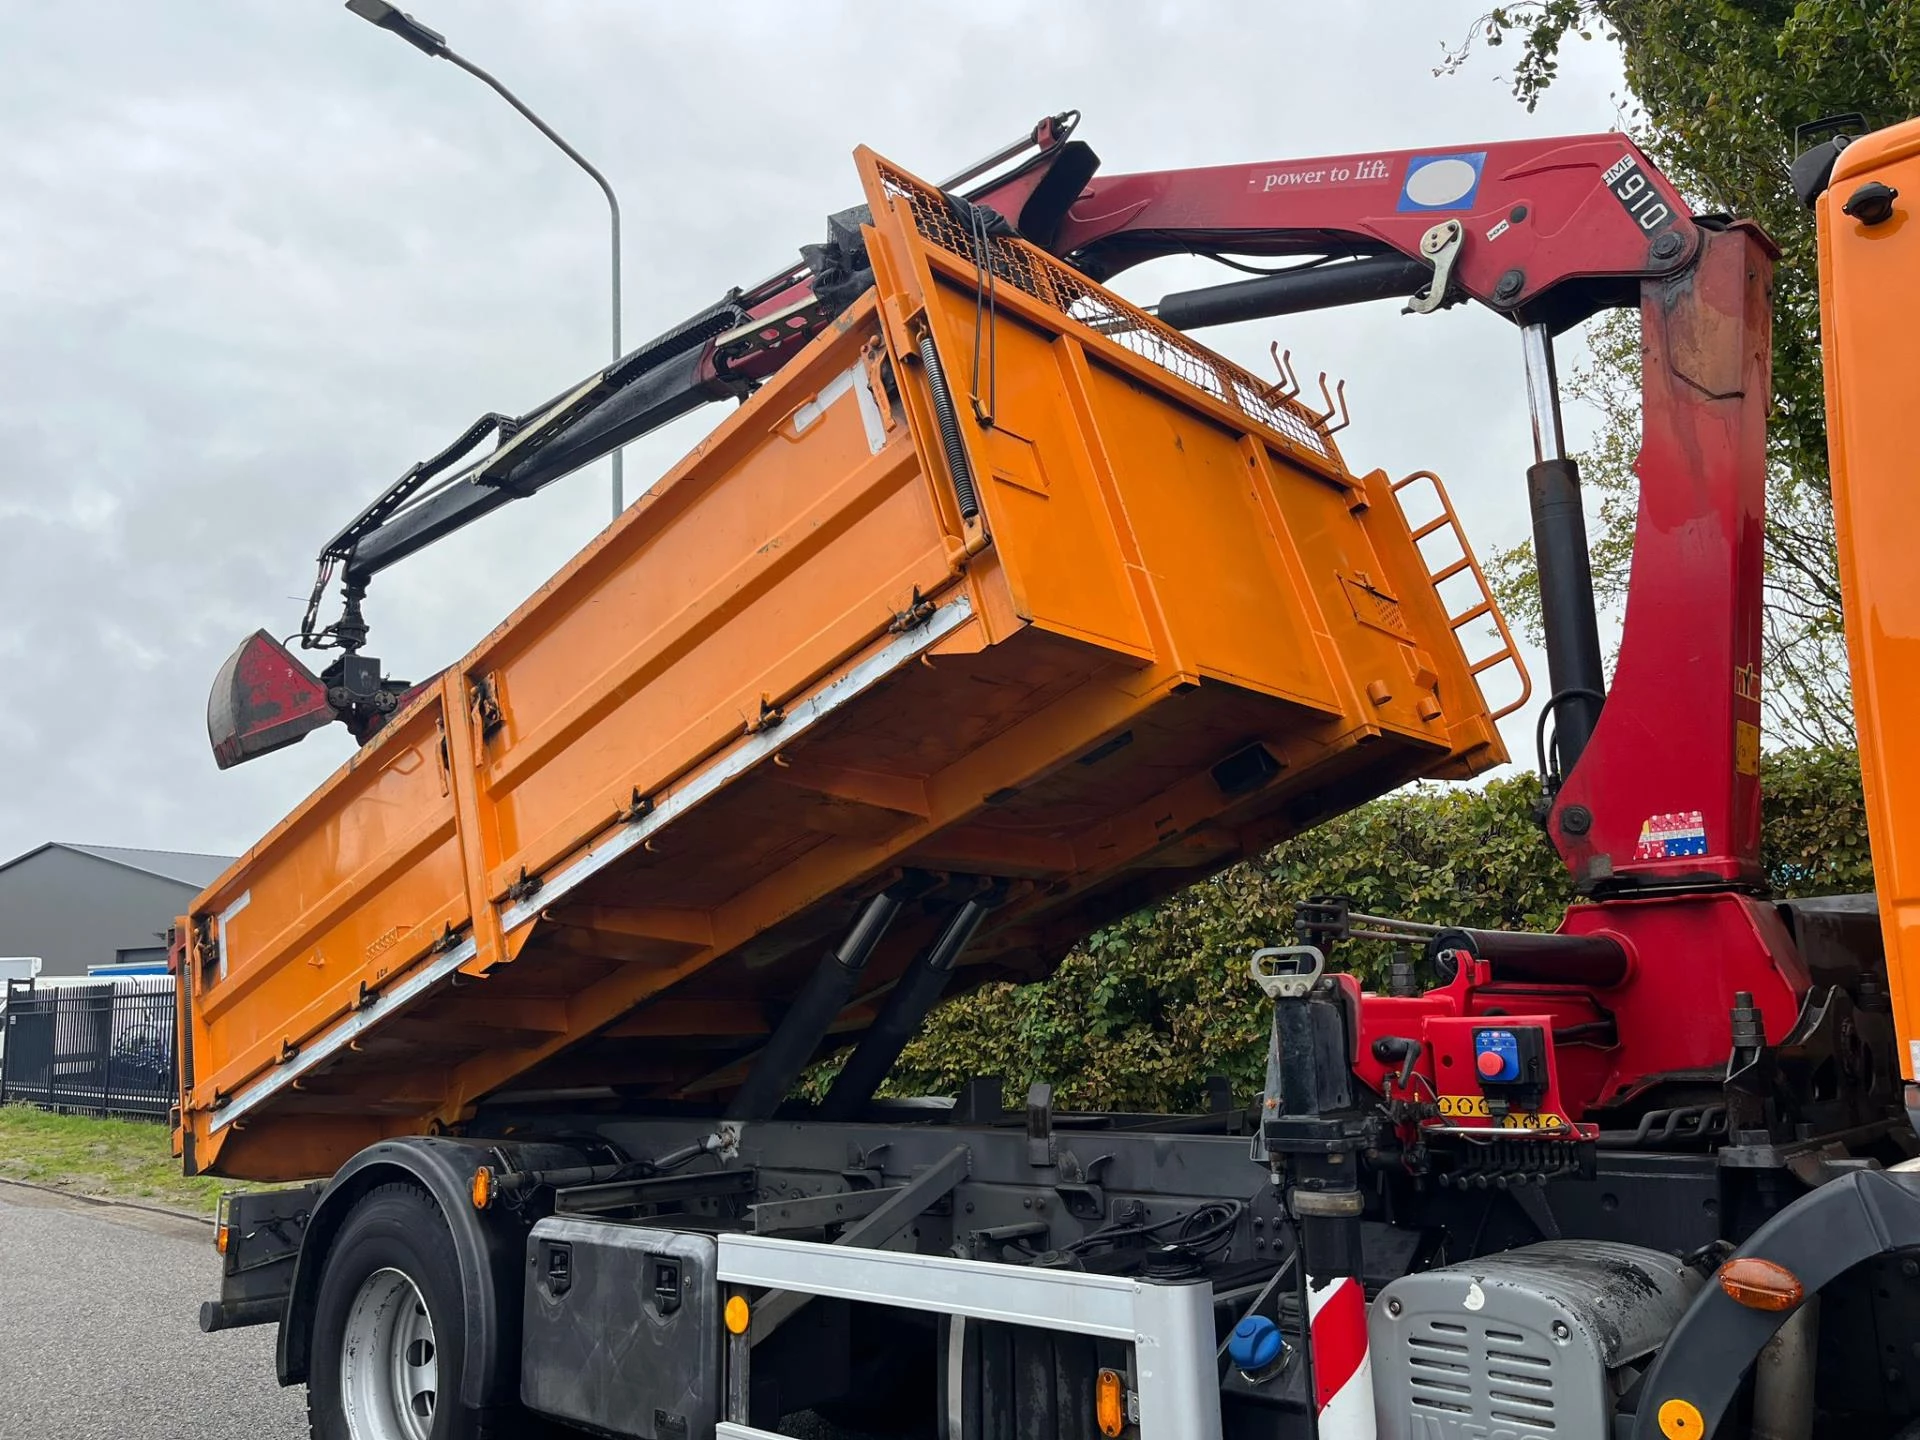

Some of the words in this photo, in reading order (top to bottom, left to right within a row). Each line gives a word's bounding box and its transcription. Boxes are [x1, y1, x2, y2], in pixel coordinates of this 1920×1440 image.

[1263, 170, 1326, 192] power
[1330, 167, 1350, 182] to
[1353, 159, 1390, 180] lift.
[1602, 155, 1632, 185] HMF
[1617, 174, 1668, 230] 910
